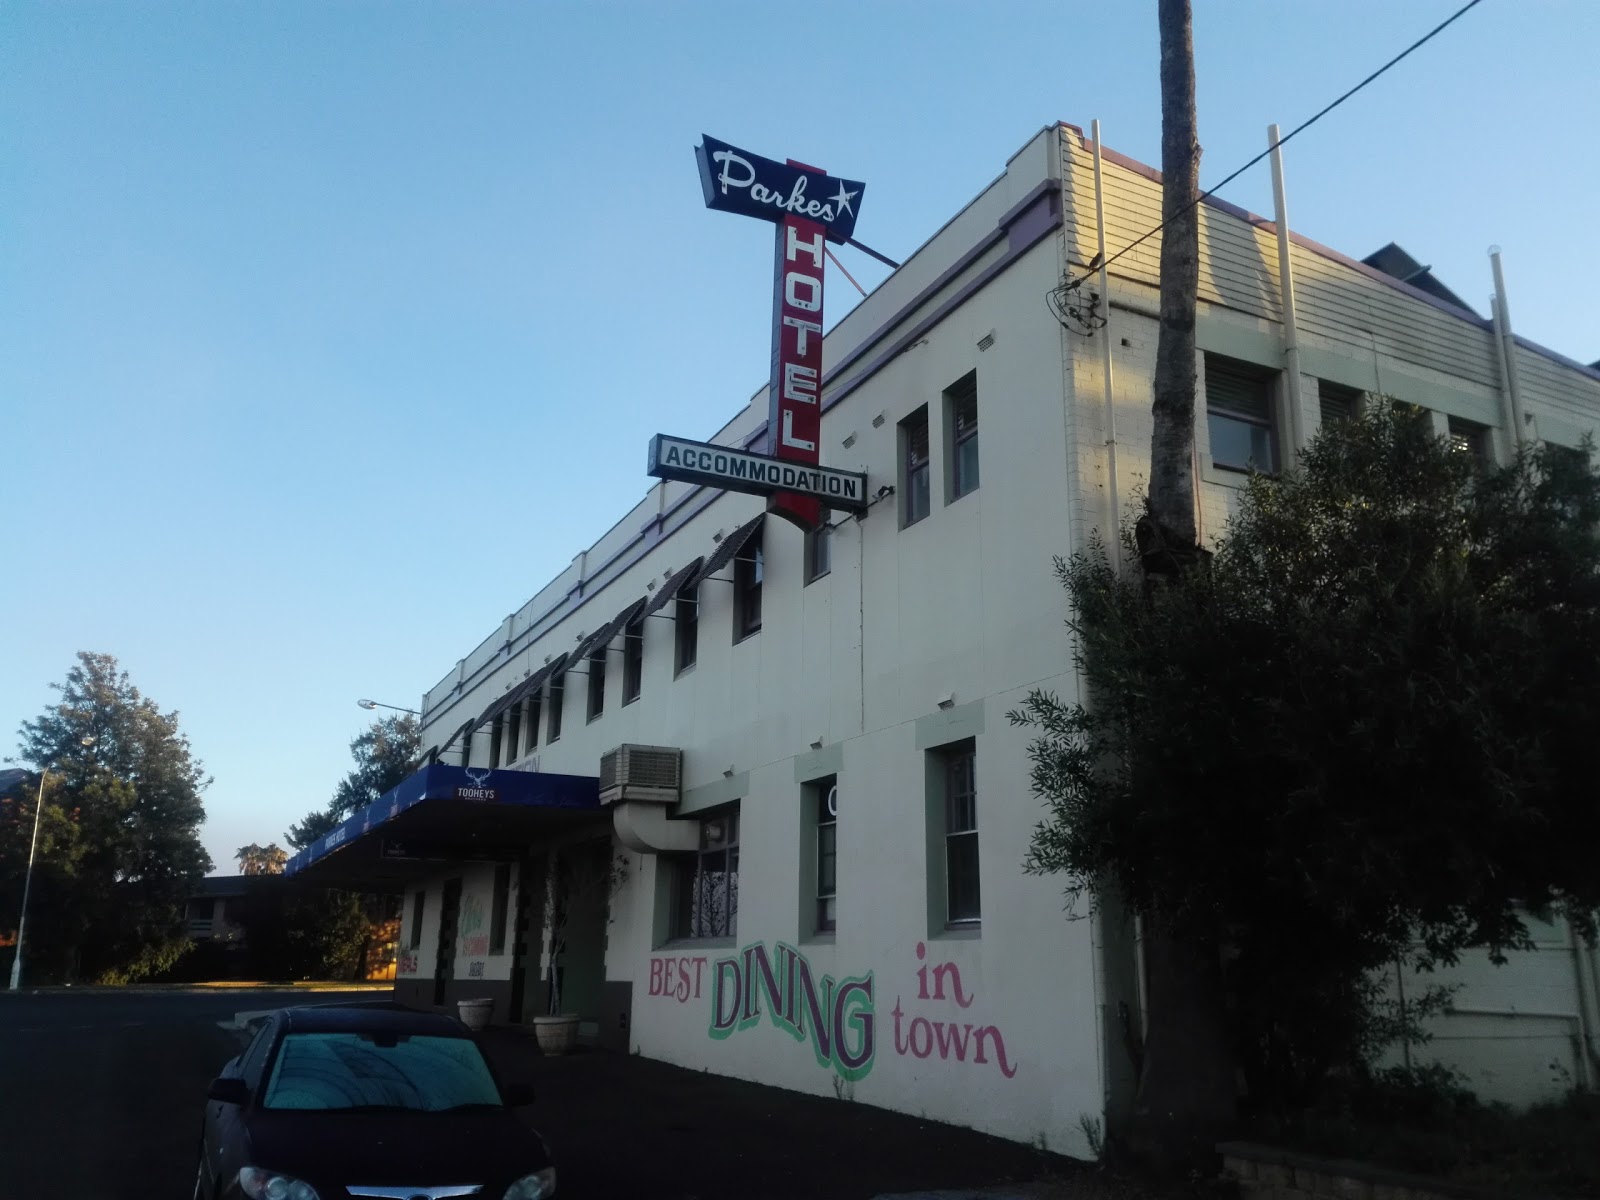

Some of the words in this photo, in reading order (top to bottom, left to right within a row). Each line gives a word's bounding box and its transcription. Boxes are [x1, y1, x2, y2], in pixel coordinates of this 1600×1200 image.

[713, 150, 835, 222] Parkes
[782, 225, 823, 452] HOTEL
[665, 445, 857, 499] ACCOMMODATION
[457, 787, 495, 799] TOOHEYS
[648, 957, 707, 1003] BEST
[711, 942, 874, 1074] DINING
[916, 941, 974, 1008] in
[891, 995, 1018, 1079] town
